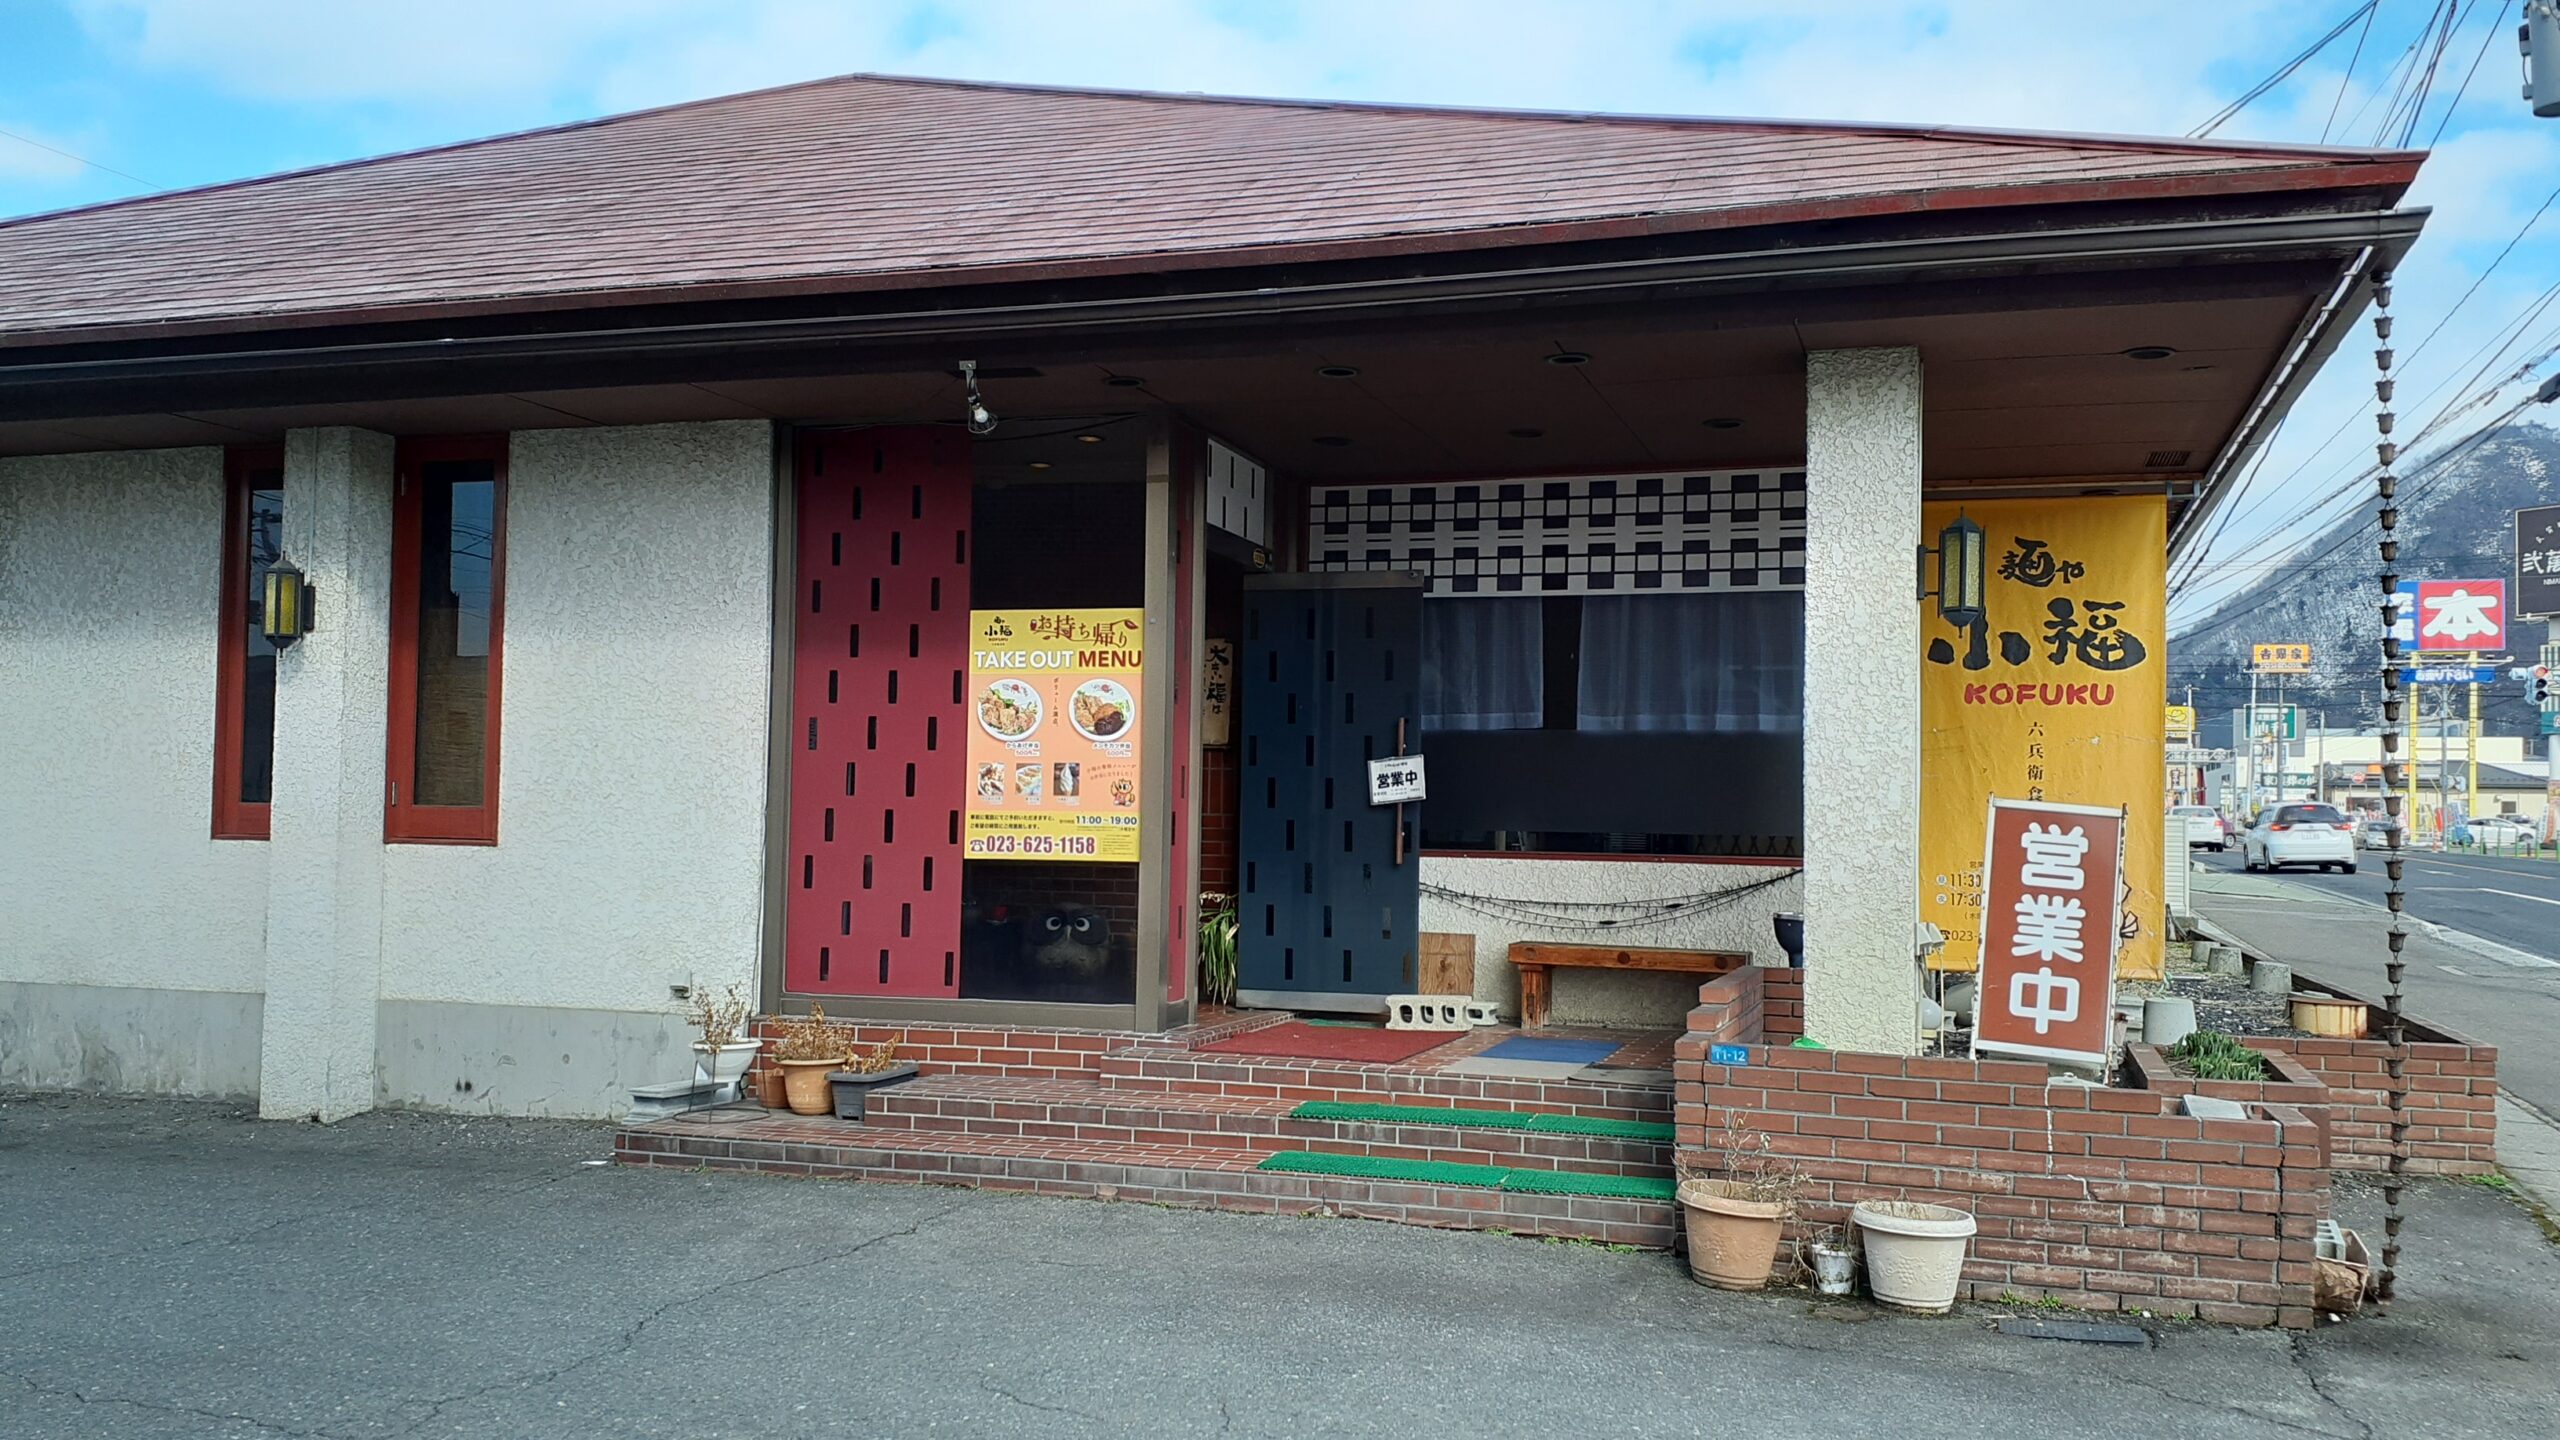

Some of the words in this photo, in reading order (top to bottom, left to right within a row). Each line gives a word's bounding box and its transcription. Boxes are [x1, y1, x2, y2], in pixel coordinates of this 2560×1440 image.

[1996, 536, 2084, 588] 麺や
[2422, 589, 2499, 641] 本
[1037, 614, 1128, 647] お持ち帰り
[1927, 597, 2147, 671] 小福
[974, 650, 1027, 669] TAKE
[1030, 650, 1074, 669] OUT
[1078, 650, 1142, 667] MENU
[2260, 648, 2303, 660] 吉野家
[1964, 682, 2115, 707] KOFUKU
[1377, 769, 1417, 789] 営業中
[986, 835, 1096, 854] 023-625-1158
[1951, 874, 1982, 887] 11:30
[1951, 893, 1981, 906] 17:30
[1952, 931, 1981, 942] 023-
[2009, 821, 2089, 1034] 営業中
[1716, 1050, 1745, 1062] 11-12
